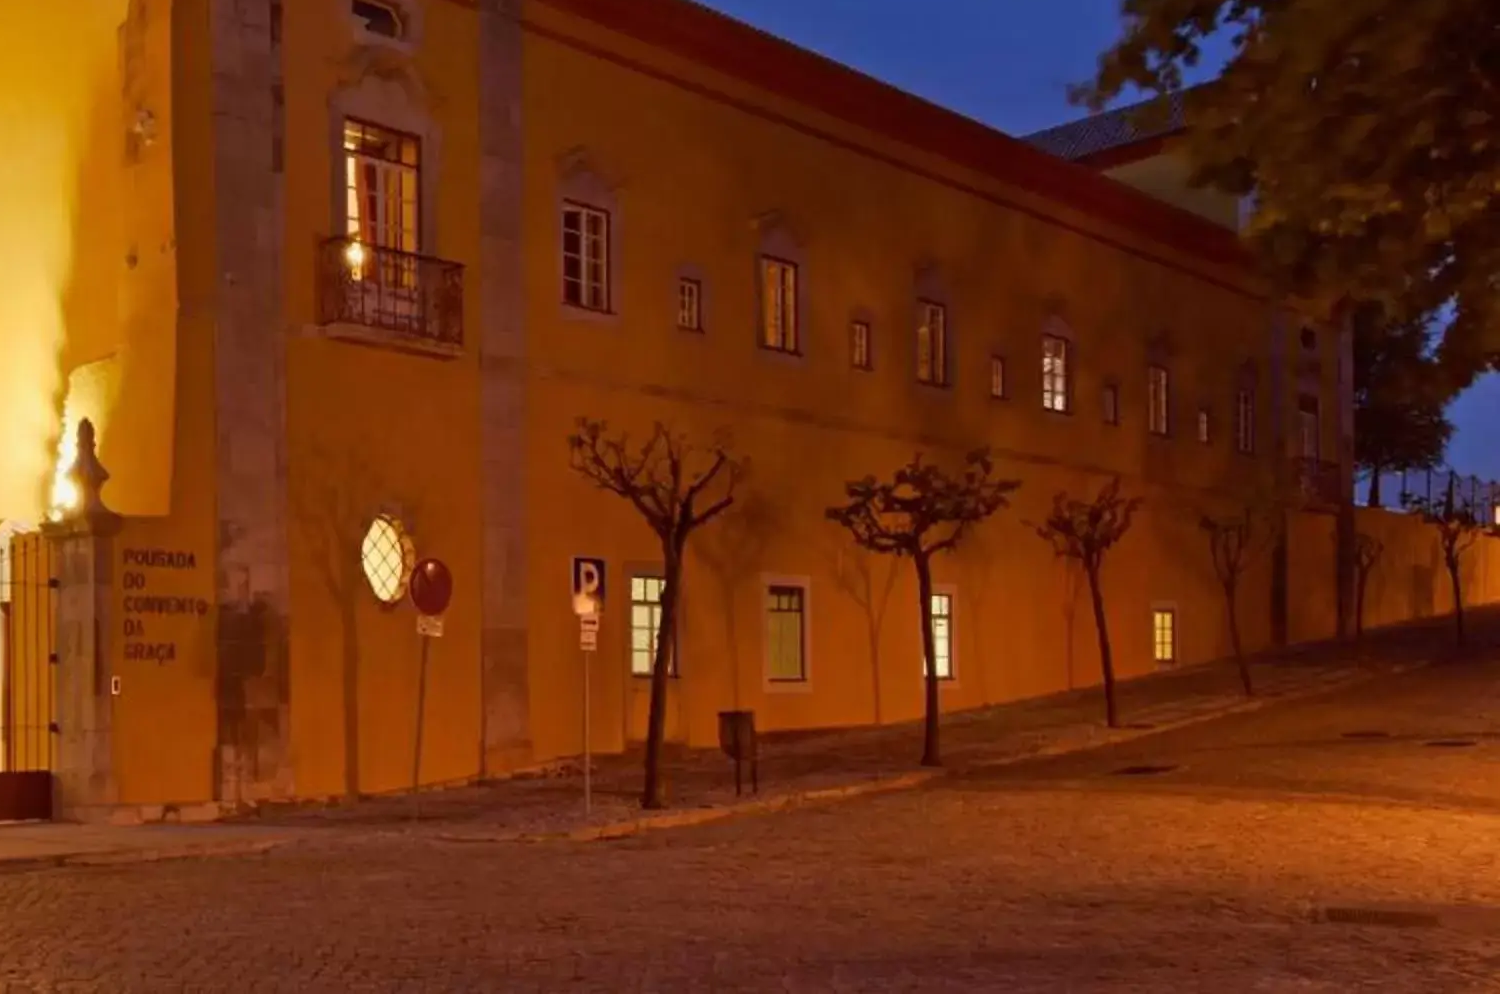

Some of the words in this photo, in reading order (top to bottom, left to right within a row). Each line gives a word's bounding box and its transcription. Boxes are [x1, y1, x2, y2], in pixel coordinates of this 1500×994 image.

[123, 549, 196, 568] POUSADA
[123, 571, 145, 589] DO
[123, 596, 208, 615] CONVENTO
[124, 619, 145, 636] DA
[124, 643, 176, 665] GRAÇA
